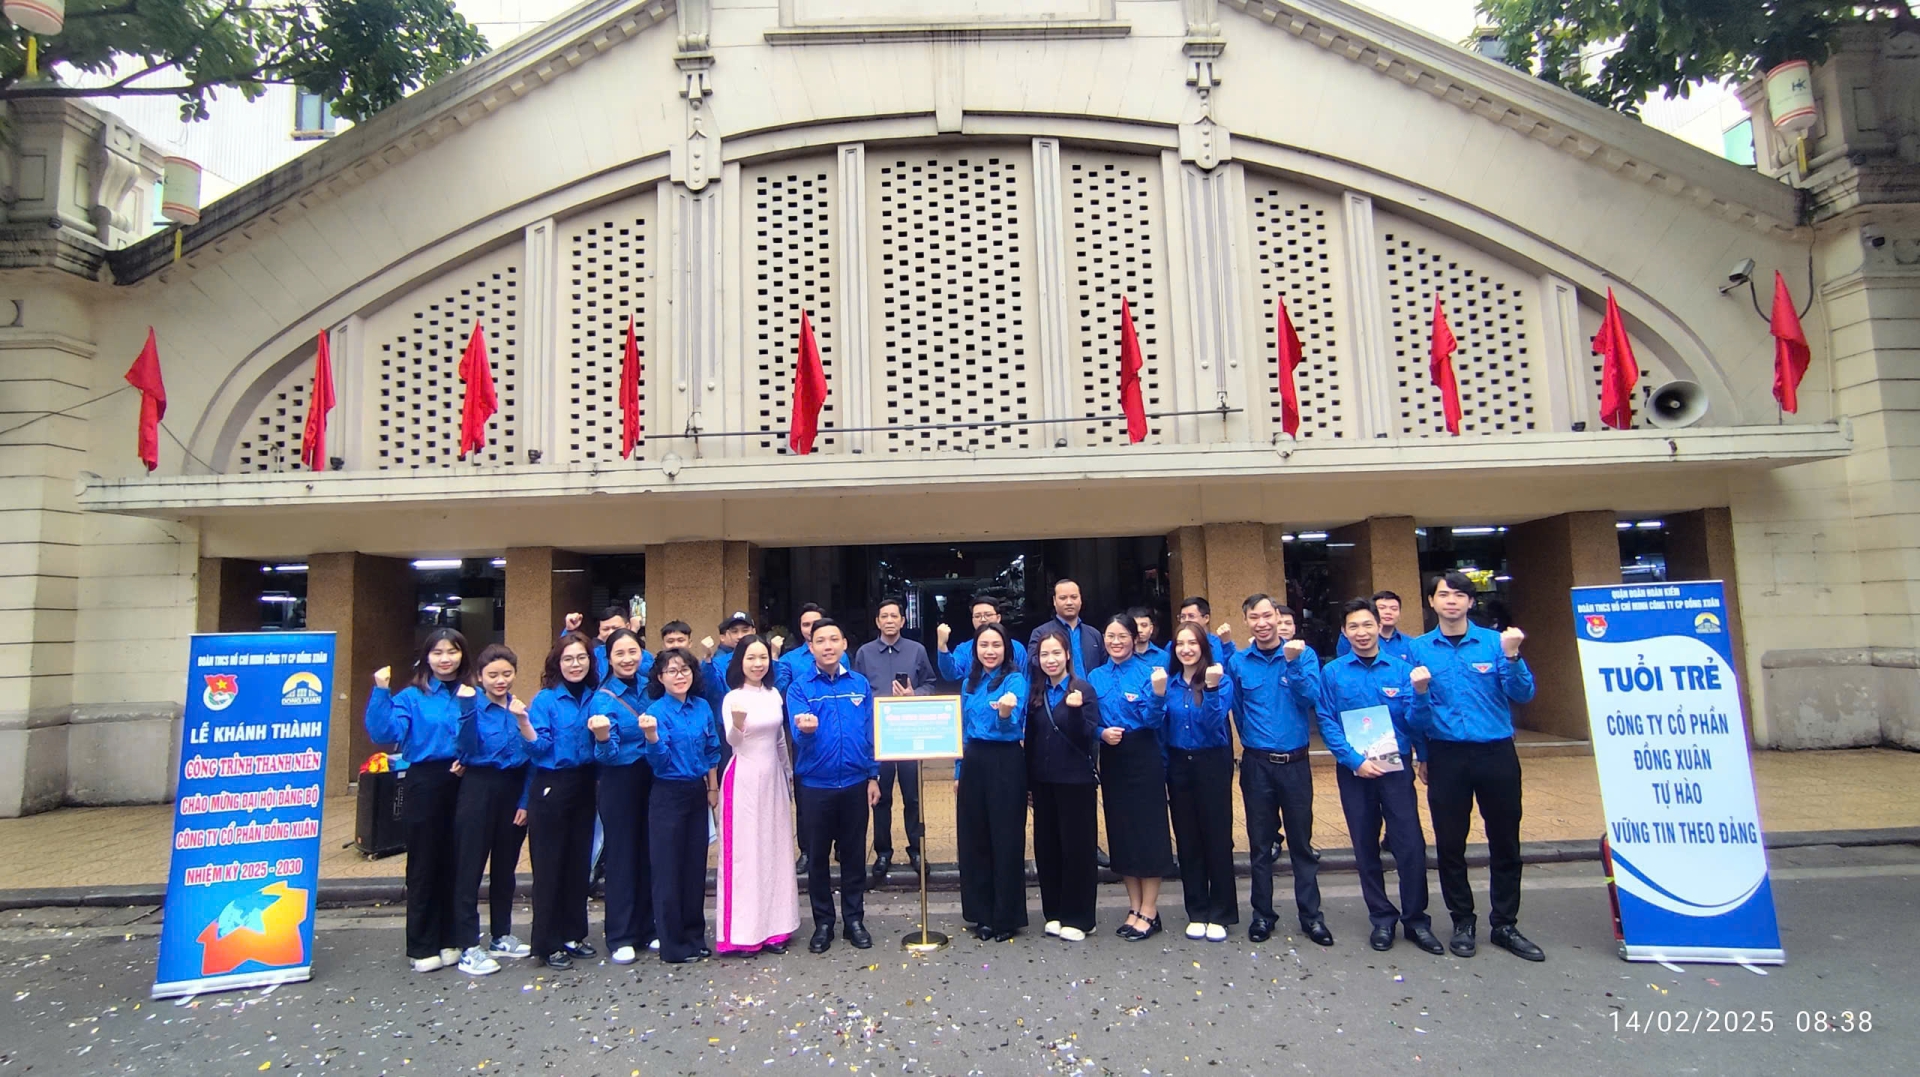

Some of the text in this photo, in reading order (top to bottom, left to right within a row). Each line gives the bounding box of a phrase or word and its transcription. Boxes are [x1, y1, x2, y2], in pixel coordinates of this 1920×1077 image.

[1599, 654, 1722, 692] TUỔI TRẺ
[190, 720, 322, 744] LỄ KHÁNH THÀNH
[1607, 705, 1729, 736] CÔNG TY CỔ PHẦN
[186, 748, 321, 778] CÔNG TRÌNH THANH NIÊN
[1634, 742, 1712, 770] ĐỒNG XUÂN
[182, 784, 319, 814] CHÀO MỪNG ĐẠI HỘI ĐẢNG BỘ
[1652, 778, 1702, 809] TỰ HÀO
[176, 817, 318, 848] CÔNG TY CỔ PHẦN ĐỒNG XUÂN
[1612, 816, 1757, 844] VỮNG TIN THEO ĐẢNG
[186, 861, 222, 886] NHIỆM
[225, 861, 240, 881] KỲ
[241, 862, 267, 879] 2025
[276, 859, 302, 875] 2030
